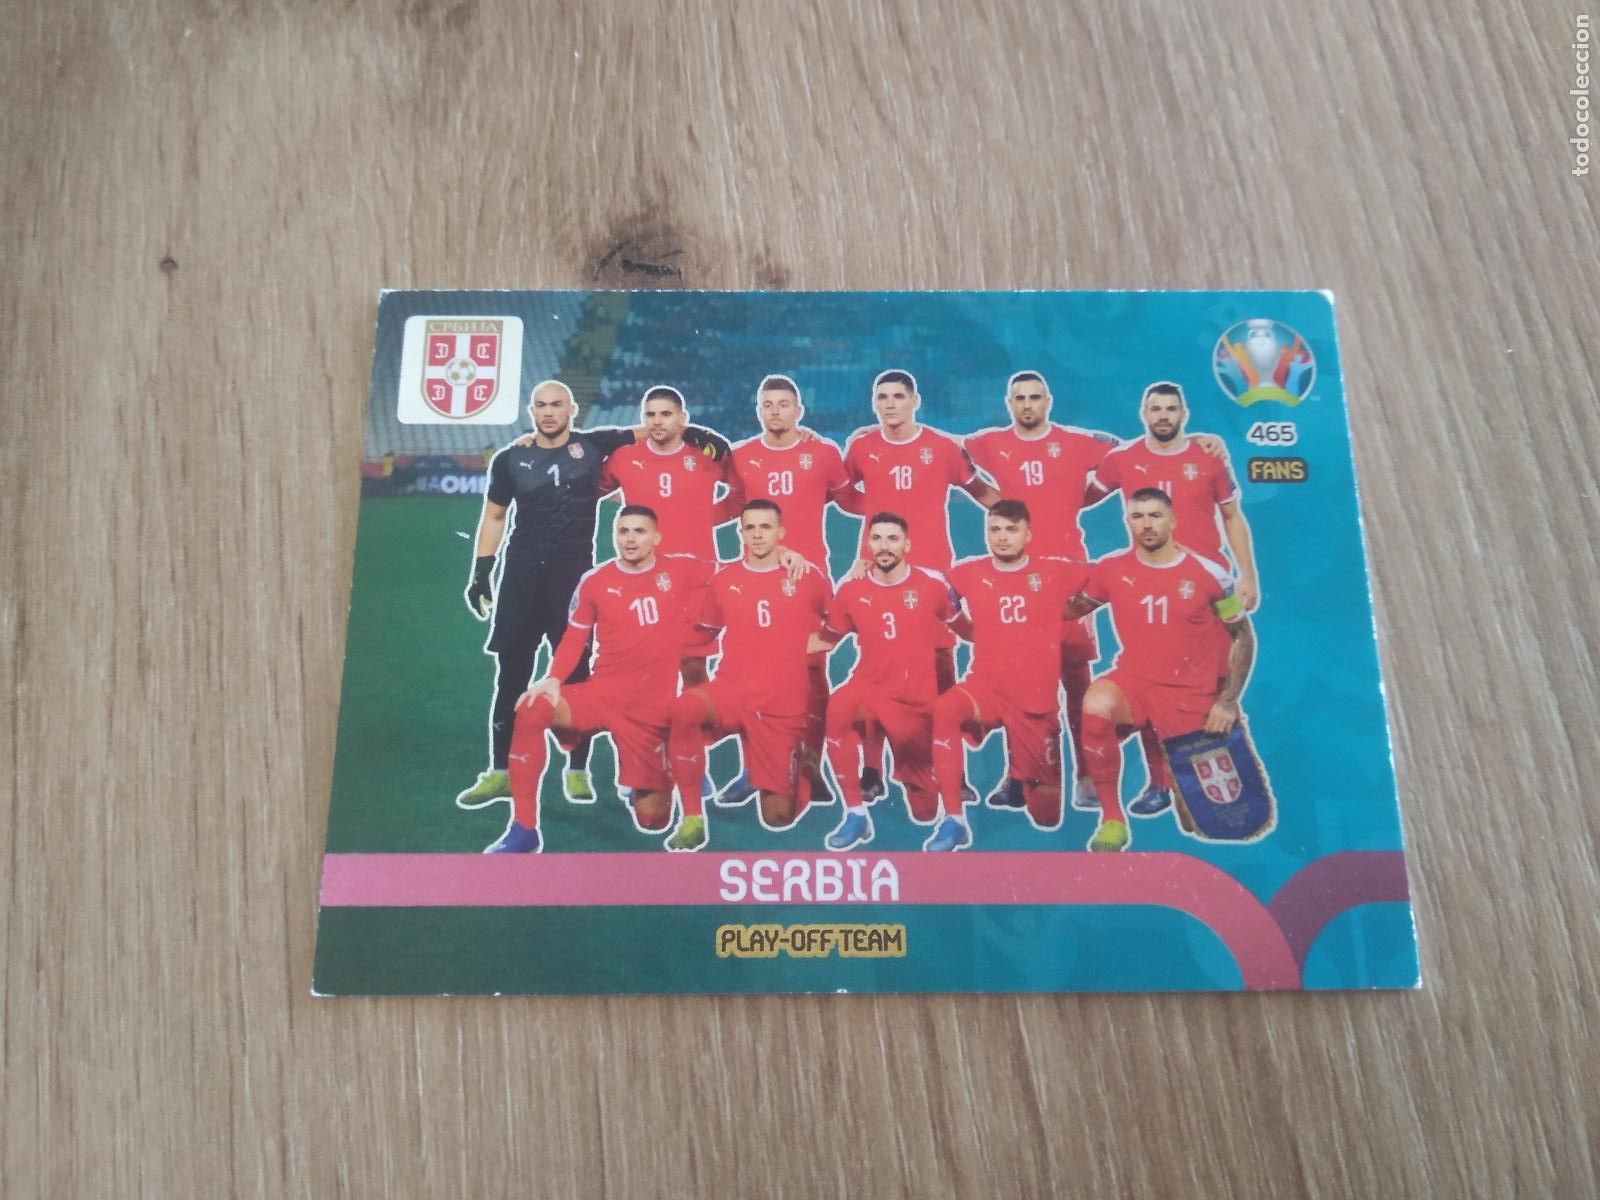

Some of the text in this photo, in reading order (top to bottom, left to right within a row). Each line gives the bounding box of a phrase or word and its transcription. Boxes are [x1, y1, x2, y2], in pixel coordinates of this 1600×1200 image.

[1251, 424, 1295, 442] 465
[547, 463, 561, 487] 1
[768, 470, 794, 496] 20
[889, 465, 912, 490] 18
[1019, 460, 1044, 486] 19
[1250, 460, 1305, 480] FANS
[659, 472, 673, 497] 9
[629, 596, 660, 627] 10
[757, 600, 771, 628] 6
[999, 595, 1028, 623] 22
[1140, 594, 1168, 625] 11
[882, 611, 896, 640] 3
[719, 858, 900, 902] SERBIA
[721, 928, 903, 953] PLAY-OFF TEAM
